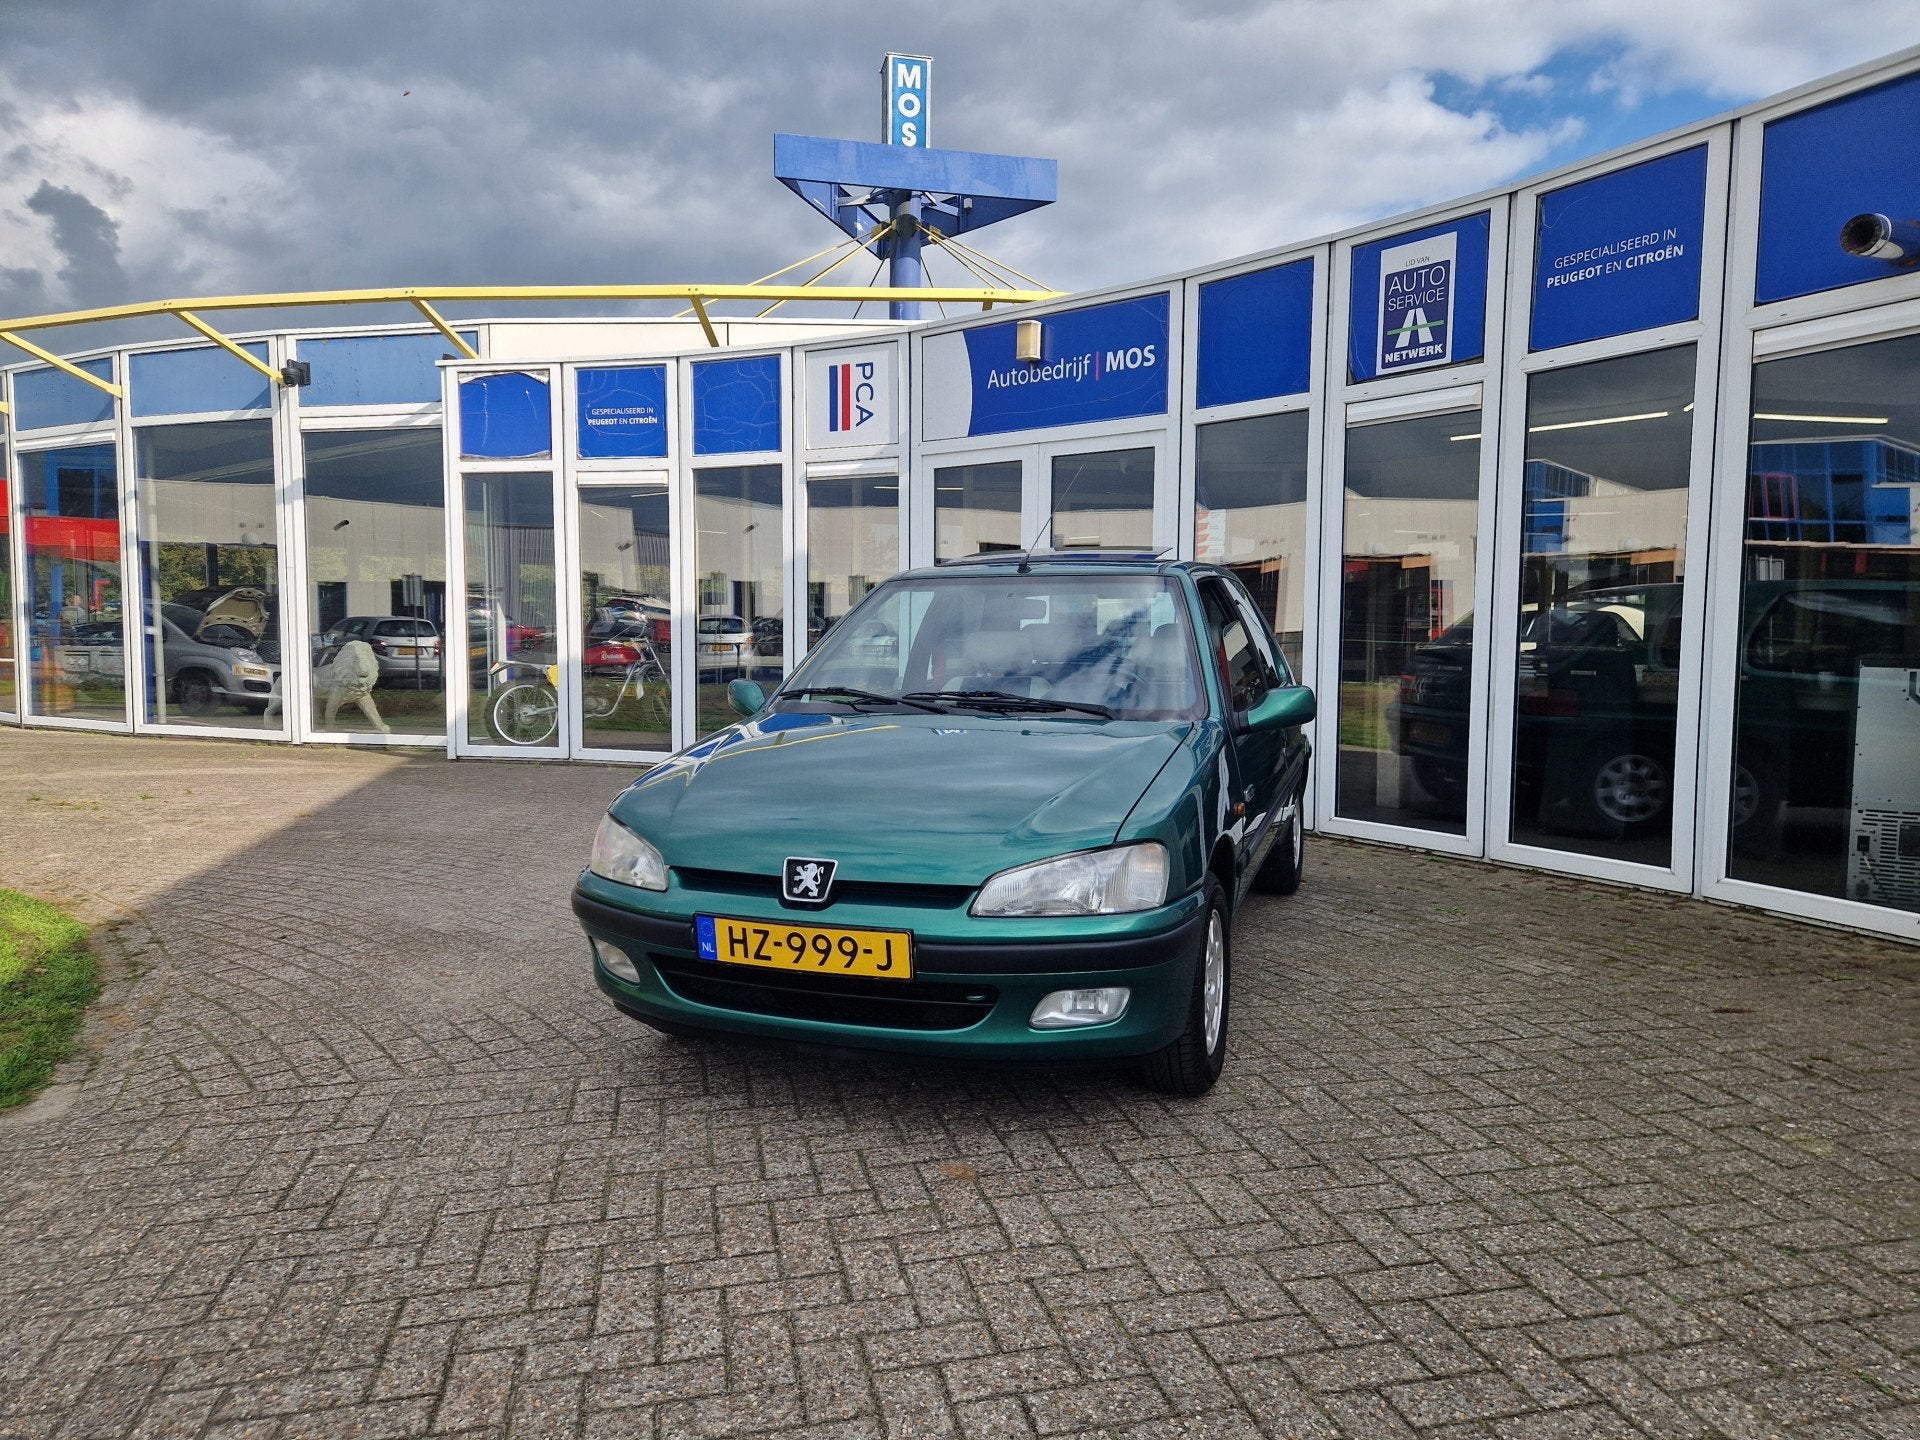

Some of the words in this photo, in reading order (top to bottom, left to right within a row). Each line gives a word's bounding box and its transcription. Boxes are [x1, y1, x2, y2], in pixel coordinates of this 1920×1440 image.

[897, 63, 921, 147] MOS
[1416, 255, 1431, 265] VAN
[1554, 232, 1659, 269] GESPECIALISEERD
[1663, 228, 1677, 241] IN
[1388, 265, 1446, 296] AUTO
[1546, 265, 1602, 288] PEUGEOT
[1605, 260, 1622, 274] EN
[1625, 244, 1684, 269] CITROËN
[1388, 287, 1446, 312] SERVICE
[987, 353, 1092, 389] Autobedrijf
[1105, 344, 1156, 372] MOS
[1385, 343, 1444, 364] NETWERK
[855, 362, 875, 428] PCA
[587, 418, 618, 426] PEUGEOT
[628, 415, 658, 425] CITROËN
[591, 407, 646, 416] GESPECIALISEERD
[702, 942, 714, 953] NL
[727, 925, 893, 972] HZ-999-J
